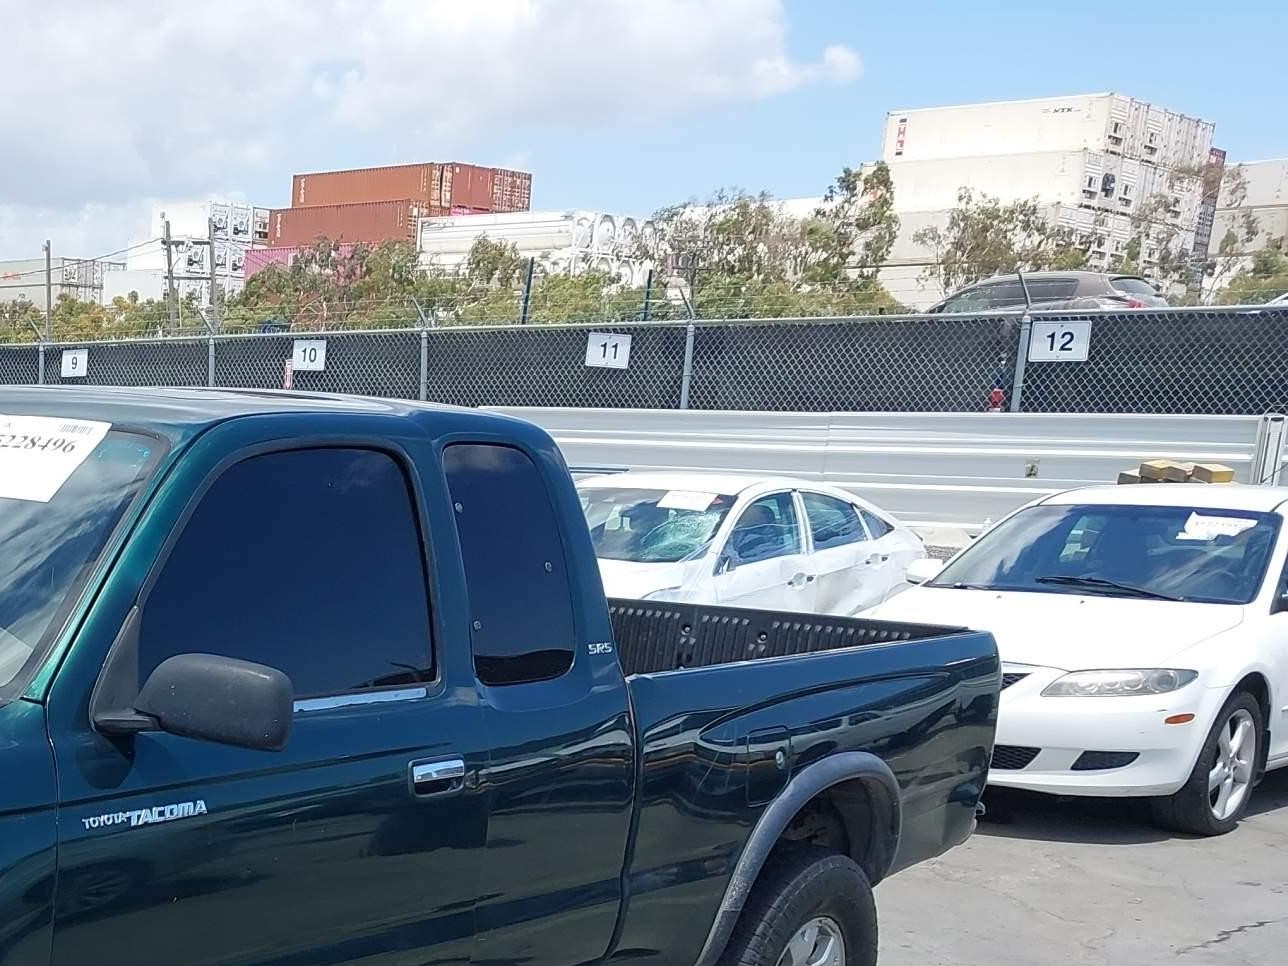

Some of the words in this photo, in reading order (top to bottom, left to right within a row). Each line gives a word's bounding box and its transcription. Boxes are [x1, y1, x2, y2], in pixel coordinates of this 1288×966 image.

[599, 341, 619, 360] 11
[1046, 331, 1075, 352] 12
[71, 356, 78, 370] 9
[301, 347, 317, 363] 10
[81, 811, 129, 830] TOYOTA
[127, 799, 208, 827] TACOMA
